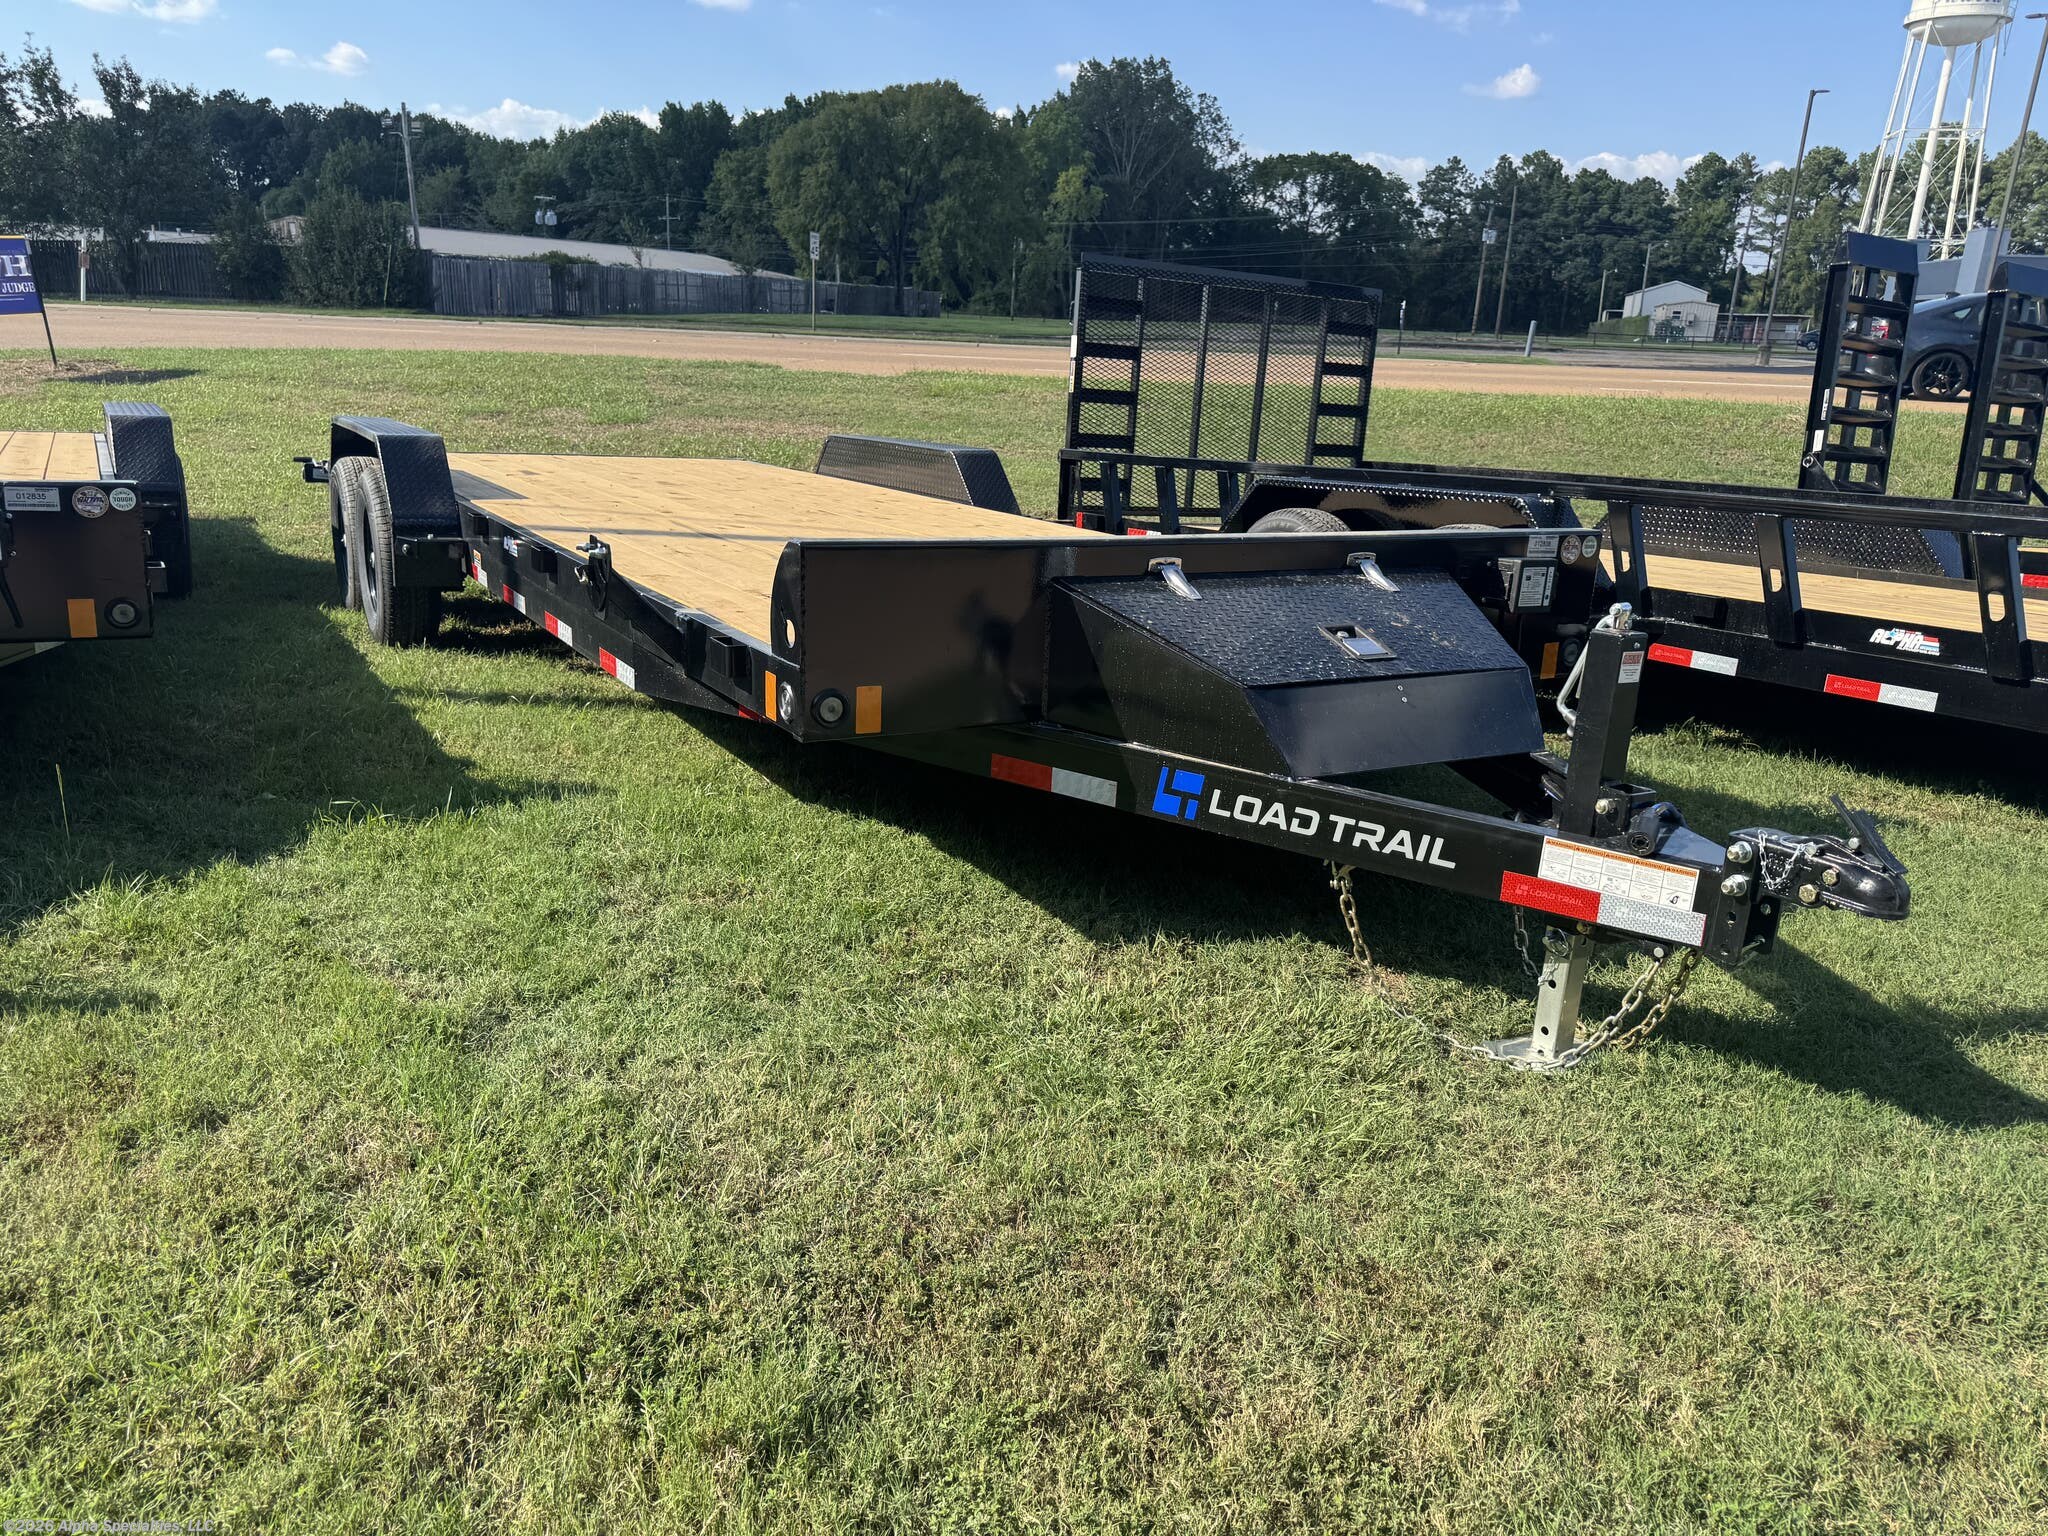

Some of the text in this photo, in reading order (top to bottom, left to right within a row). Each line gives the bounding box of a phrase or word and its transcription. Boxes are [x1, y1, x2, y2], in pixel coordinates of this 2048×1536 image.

[0, 255, 34, 277] H
[2, 282, 36, 293] JUDGE
[1869, 628, 1924, 651] ALPHA
[1209, 789, 1457, 870] LOAD TRAIL
[1529, 888, 1584, 907] LOAD TRAIL
